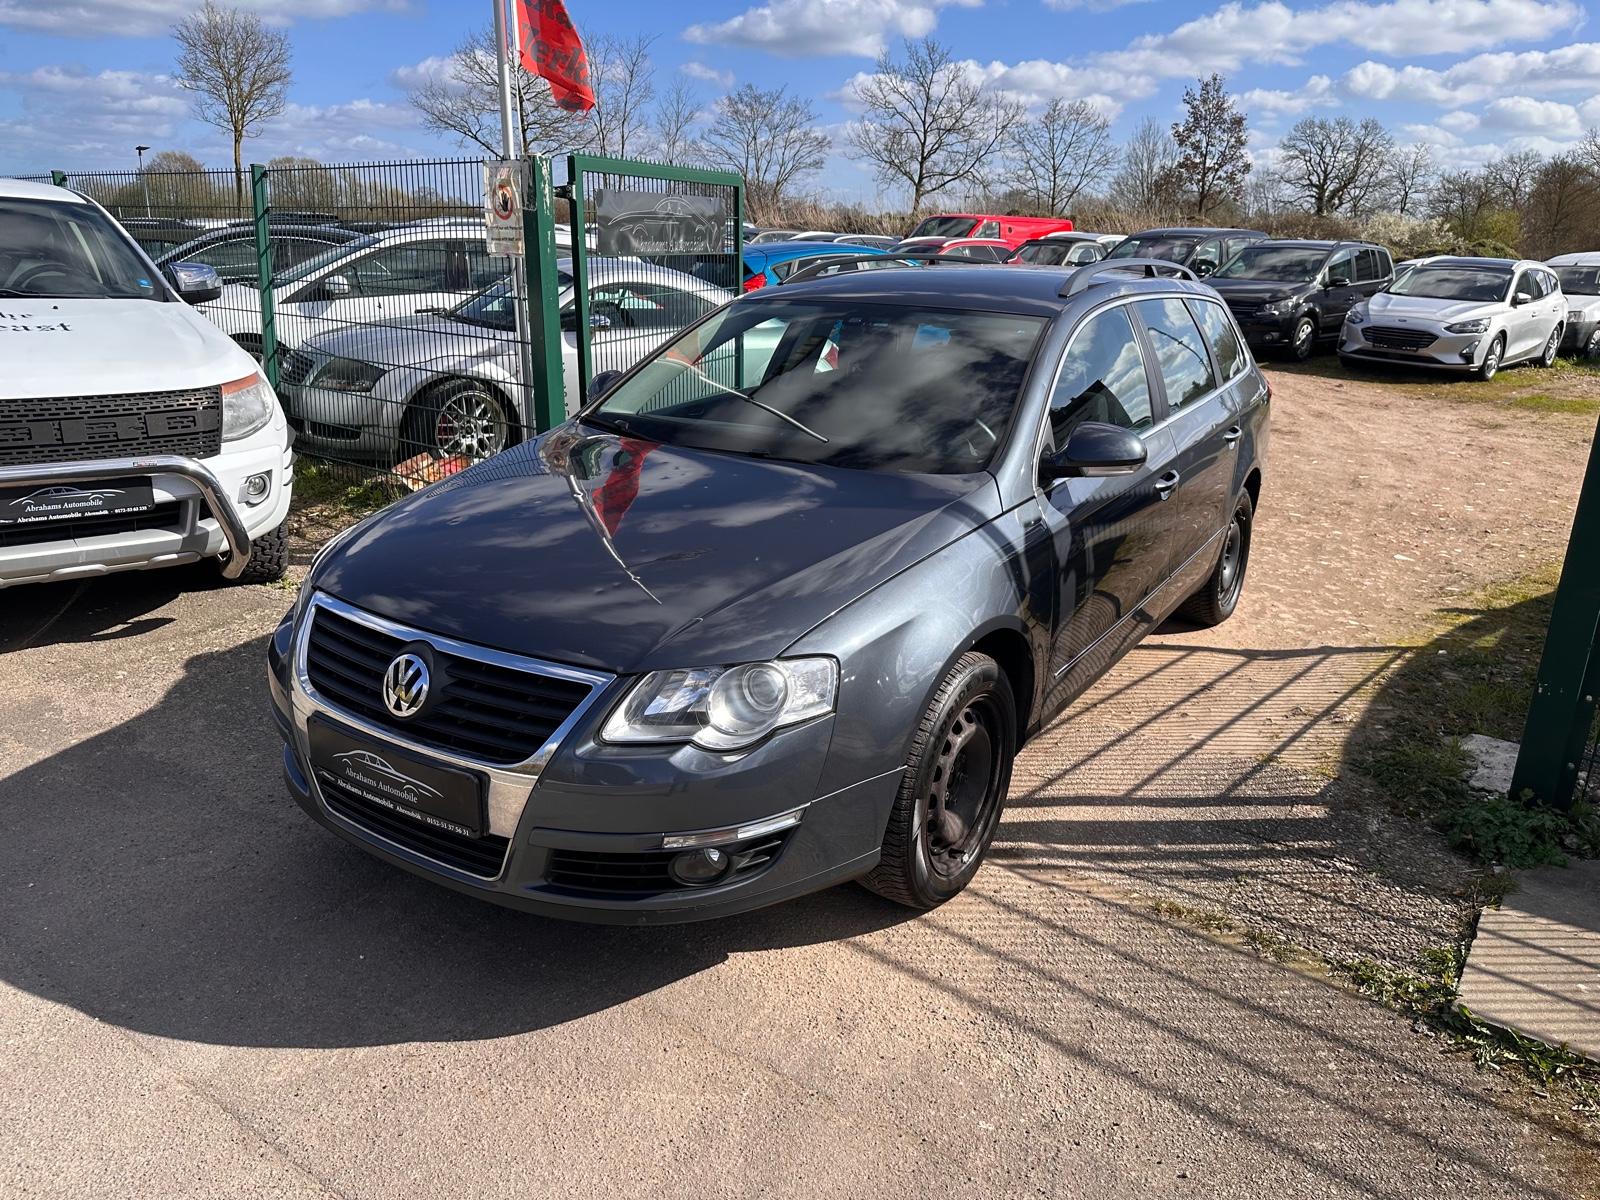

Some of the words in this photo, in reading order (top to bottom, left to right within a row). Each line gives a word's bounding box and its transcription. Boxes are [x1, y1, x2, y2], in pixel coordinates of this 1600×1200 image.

[25, 501, 61, 512] Abrahams
[62, 499, 103, 509] Automobile
[17, 515, 47, 524] Abrahams
[48, 511, 82, 521] Automobile
[337, 778, 362, 796] Abrahams
[362, 789, 394, 809] Automobile
[345, 766, 377, 787] Abrahams
[378, 781, 418, 804] Automobile
